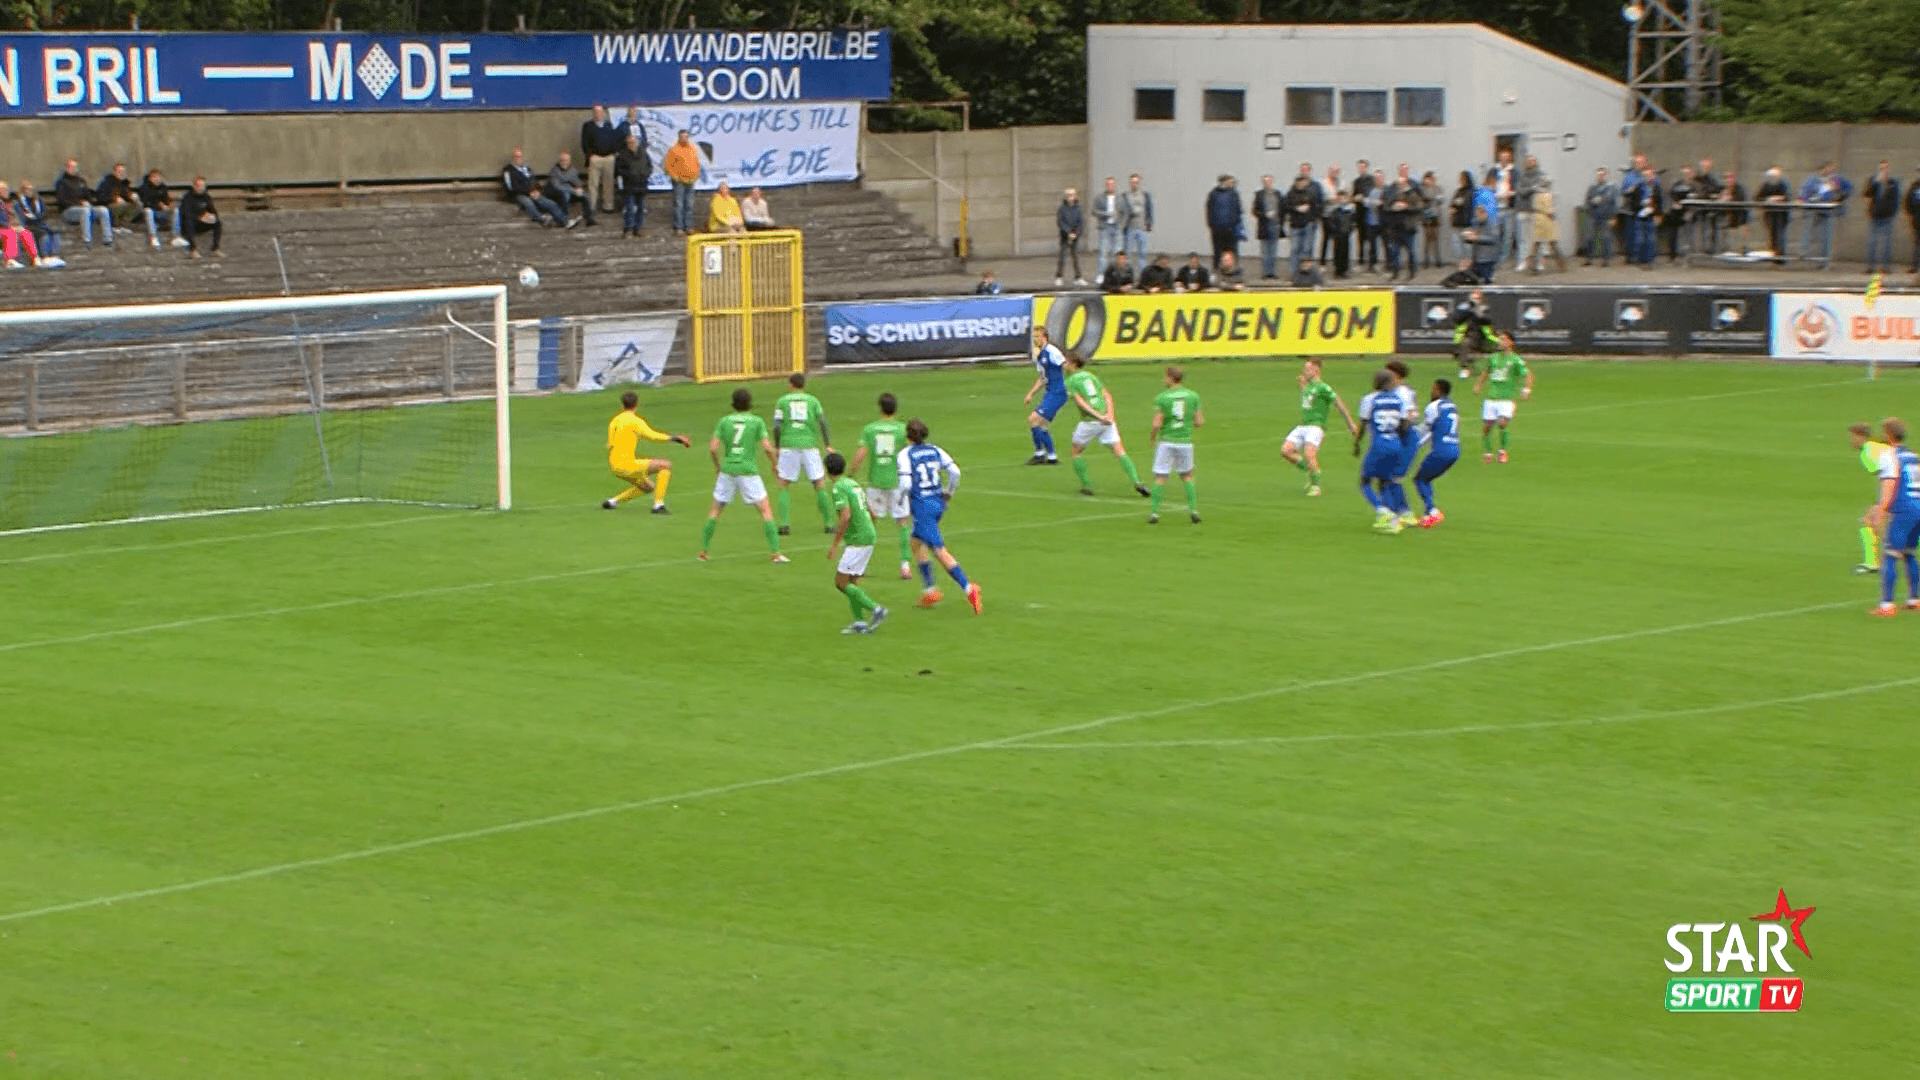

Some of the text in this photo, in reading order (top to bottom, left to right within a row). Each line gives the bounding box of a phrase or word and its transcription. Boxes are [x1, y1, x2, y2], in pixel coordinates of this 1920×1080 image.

[593, 31, 880, 64] WWW.VANDENBRIL.BE
[43, 46, 181, 105] BRIL
[680, 66, 801, 102] BOOM
[689, 108, 799, 137] BOOMKES
[809, 107, 850, 130] TILL
[741, 147, 832, 178] WE DIE
[828, 324, 860, 346] SC
[1113, 305, 1380, 343] BANDEN TOM
[733, 423, 746, 445] 7
[916, 460, 941, 488] 17
